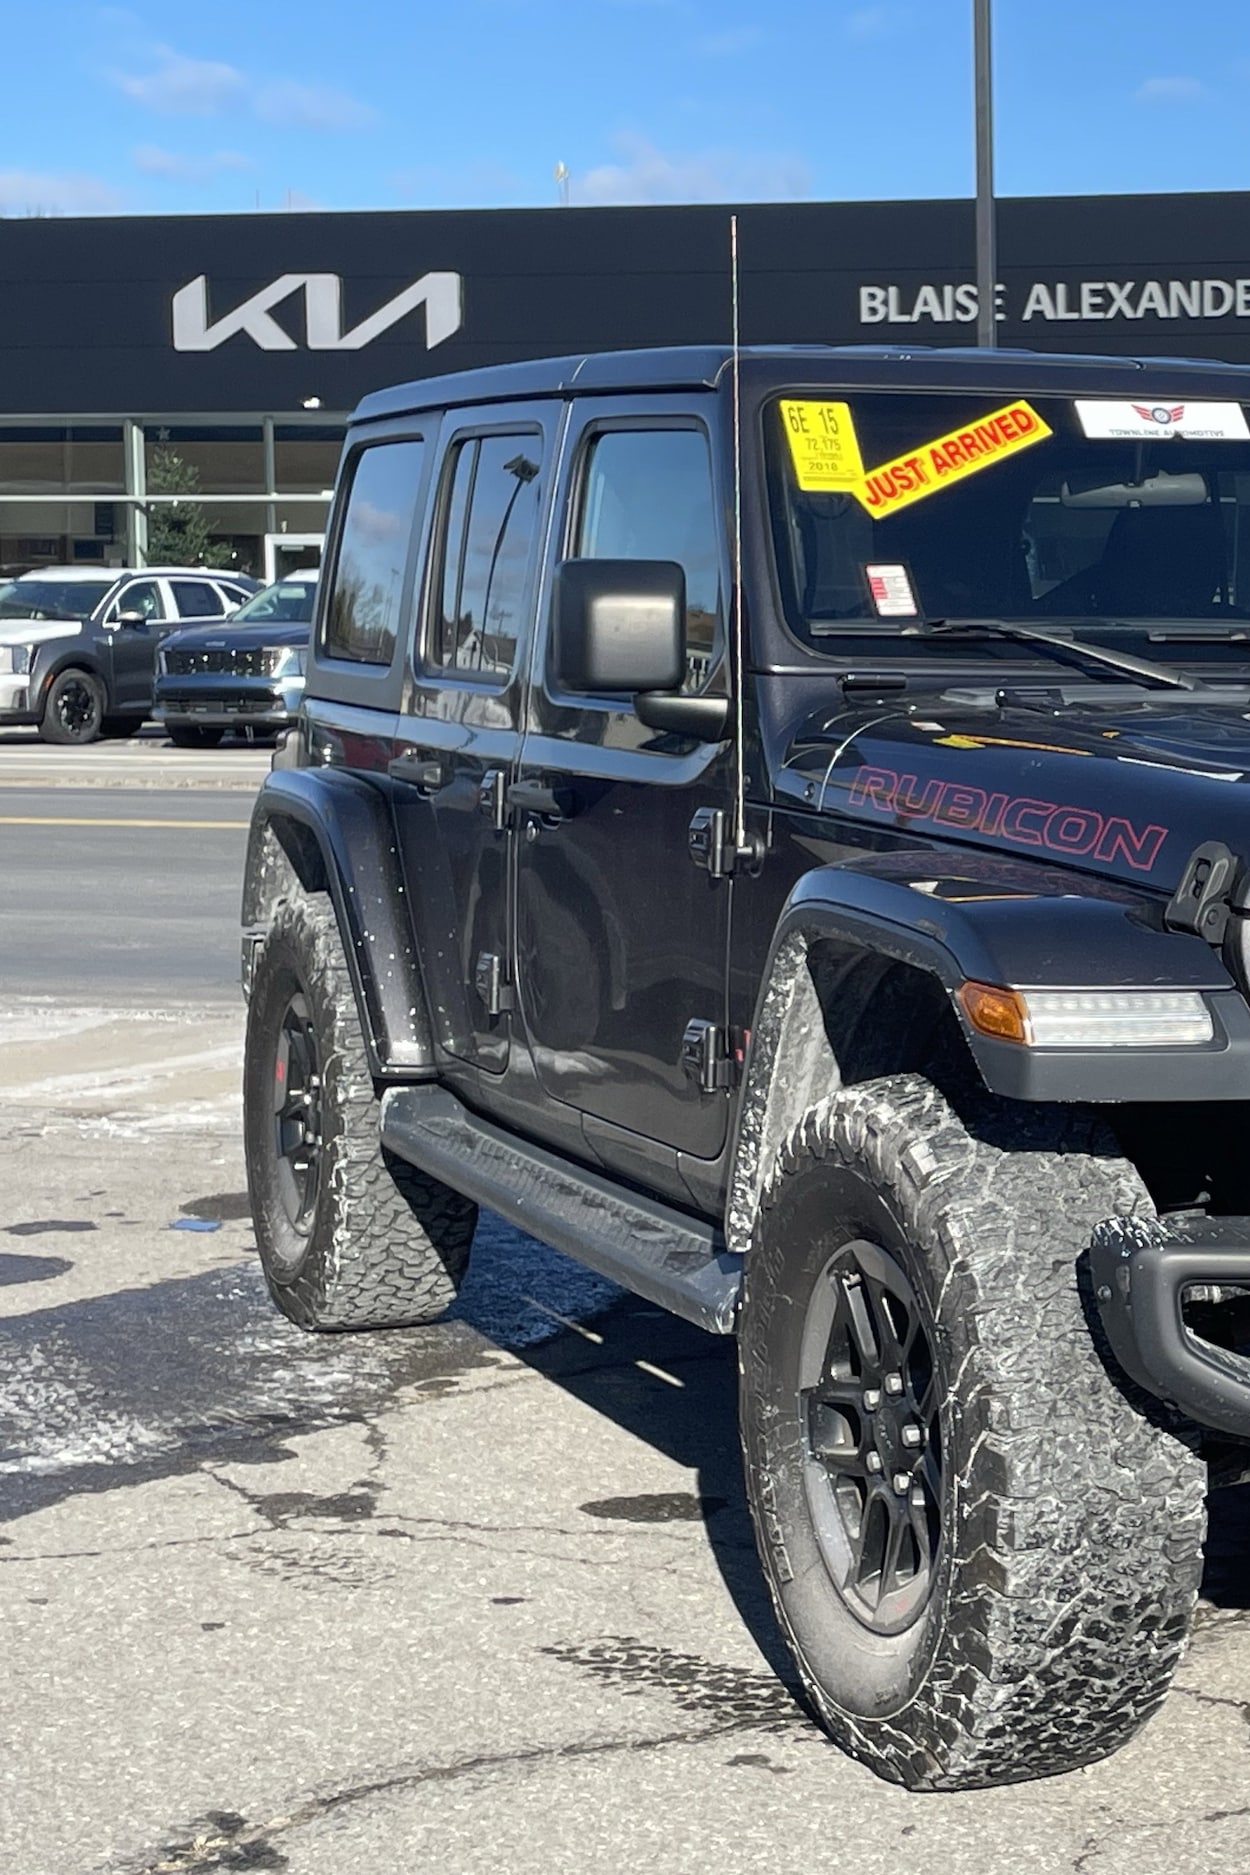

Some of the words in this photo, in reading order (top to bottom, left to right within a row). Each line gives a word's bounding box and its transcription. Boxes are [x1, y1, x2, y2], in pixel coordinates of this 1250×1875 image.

[173, 271, 461, 351] KIA
[818, 407, 839, 434] 15
[865, 457, 926, 507] JUST
[929, 407, 1037, 475] ARRIVED
[849, 765, 1168, 870] RUBICON
